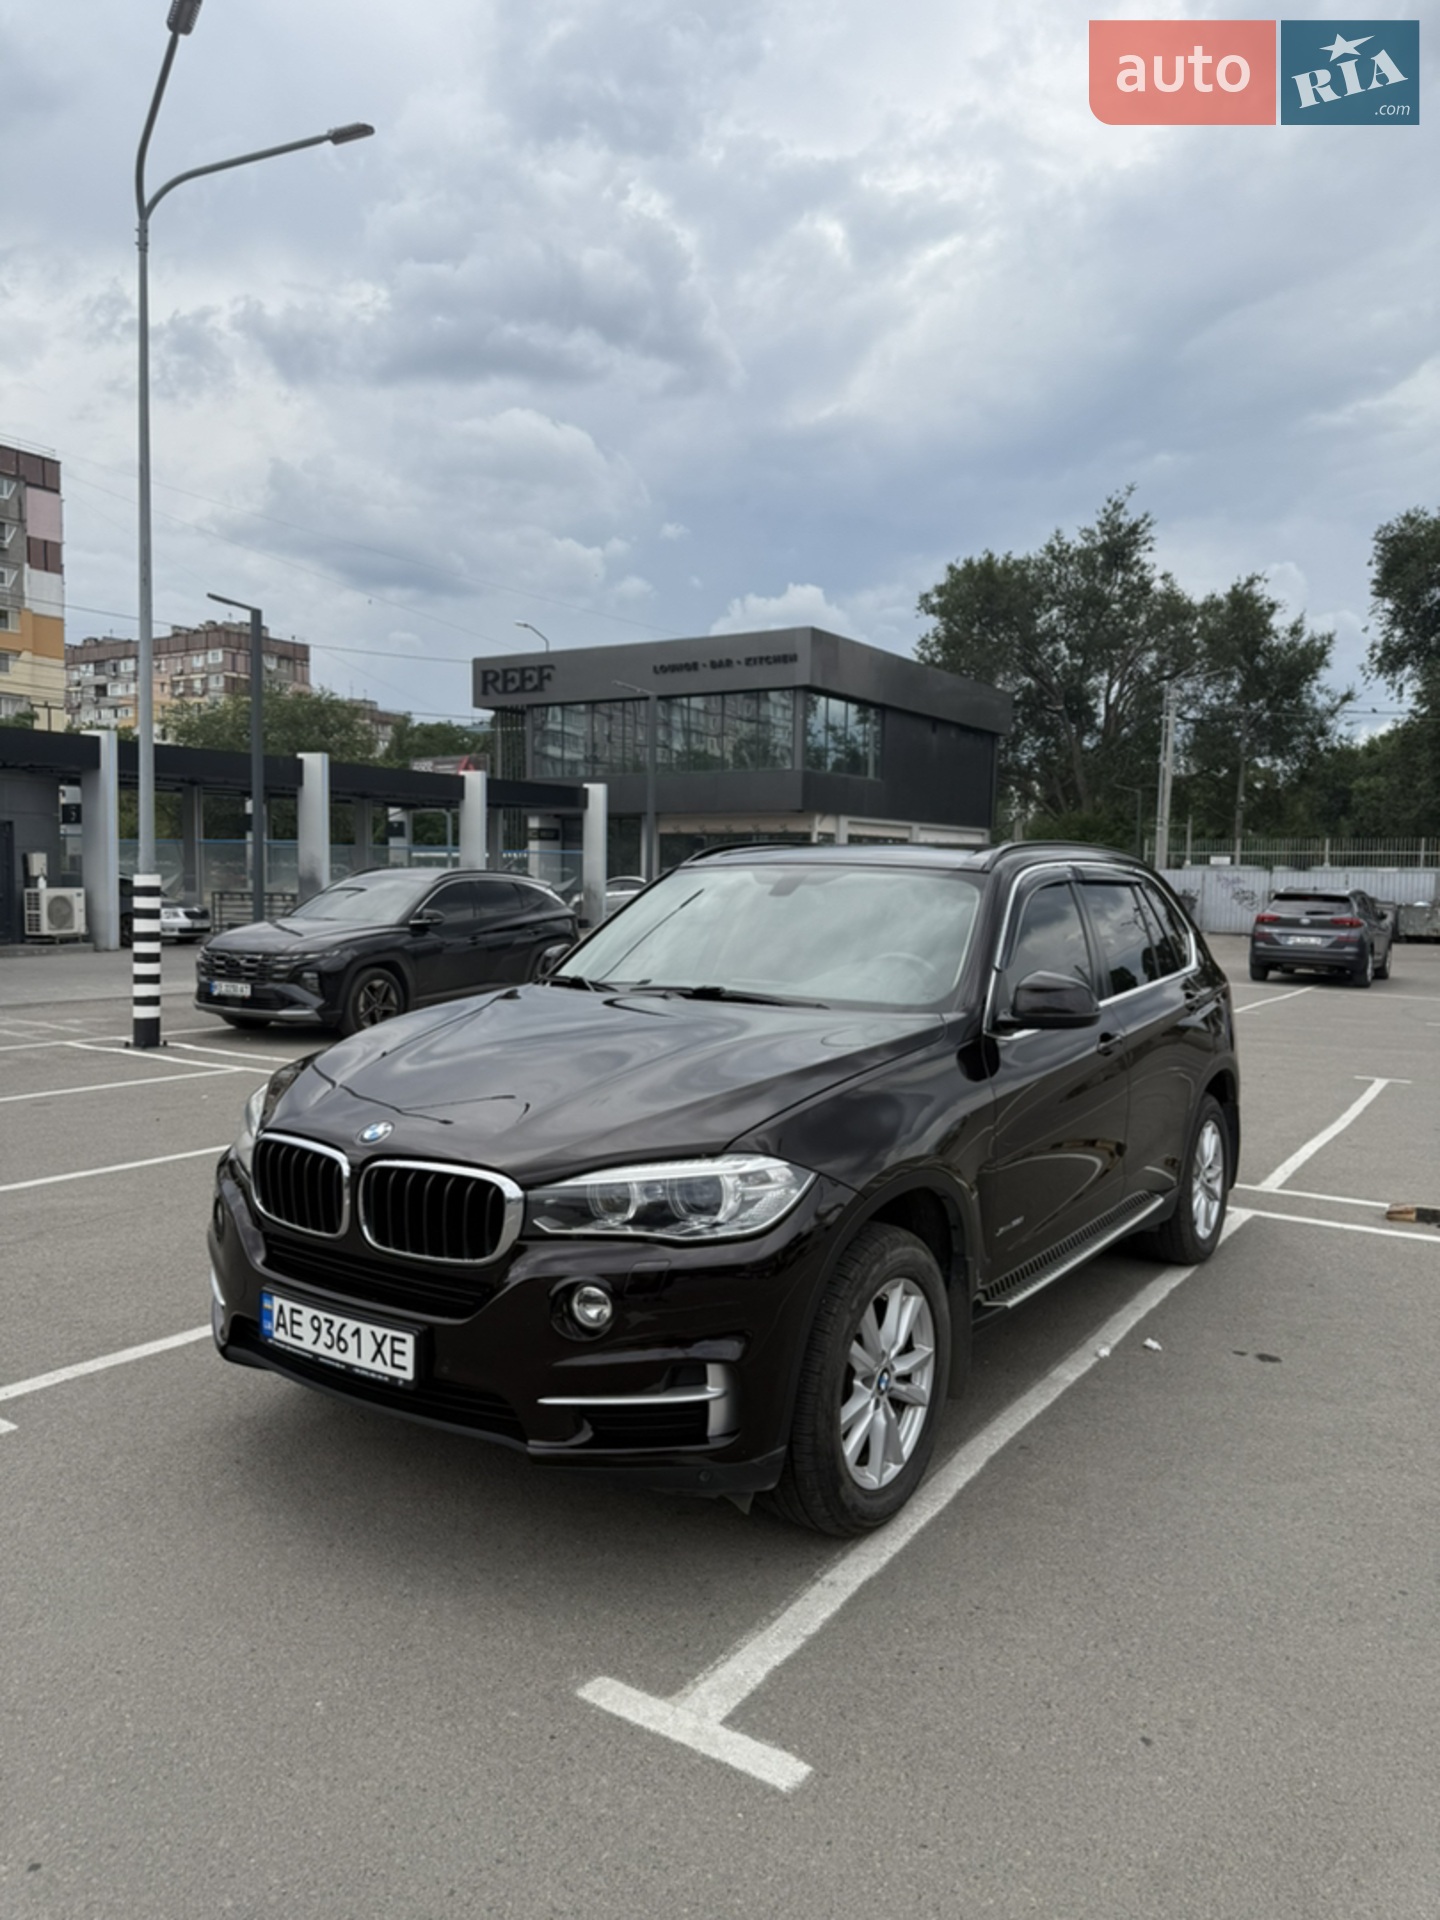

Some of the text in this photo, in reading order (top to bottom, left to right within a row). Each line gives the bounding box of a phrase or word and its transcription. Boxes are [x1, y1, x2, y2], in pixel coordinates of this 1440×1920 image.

[653, 653, 798, 674] LOUNGE BAR KITCHEN
[481, 664, 555, 696] REEF
[275, 1304, 304, 1341] AE
[310, 1314, 362, 1360] 9361
[370, 1329, 408, 1371] XE
